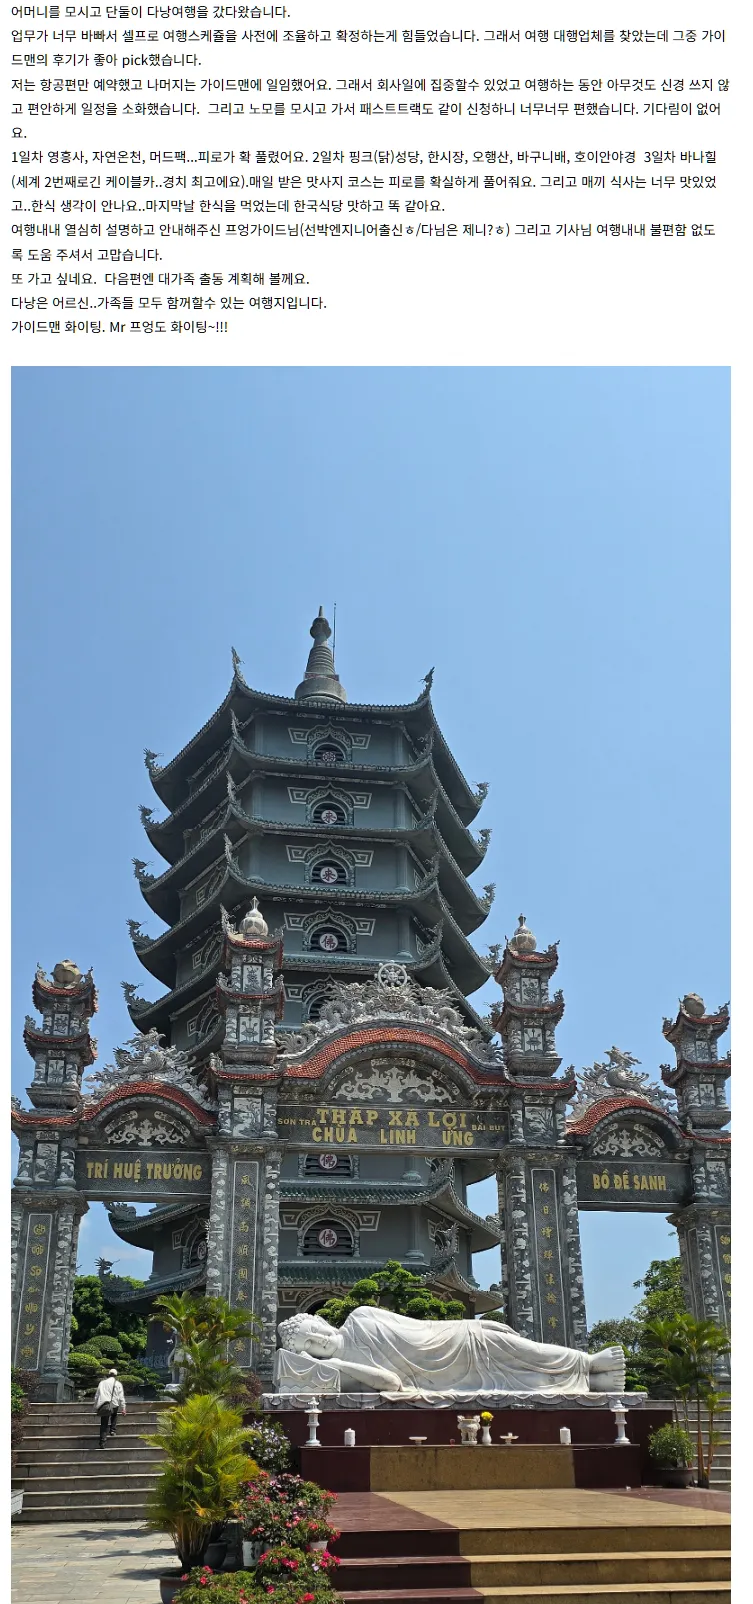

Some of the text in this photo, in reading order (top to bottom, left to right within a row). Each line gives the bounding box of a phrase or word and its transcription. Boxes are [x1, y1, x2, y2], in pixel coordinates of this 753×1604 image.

[380, 1128, 416, 1145] LINH
[86, 1158, 203, 1183] TRÍ HUỆ TRƯỞNG
[633, 1174, 667, 1191] SANH
